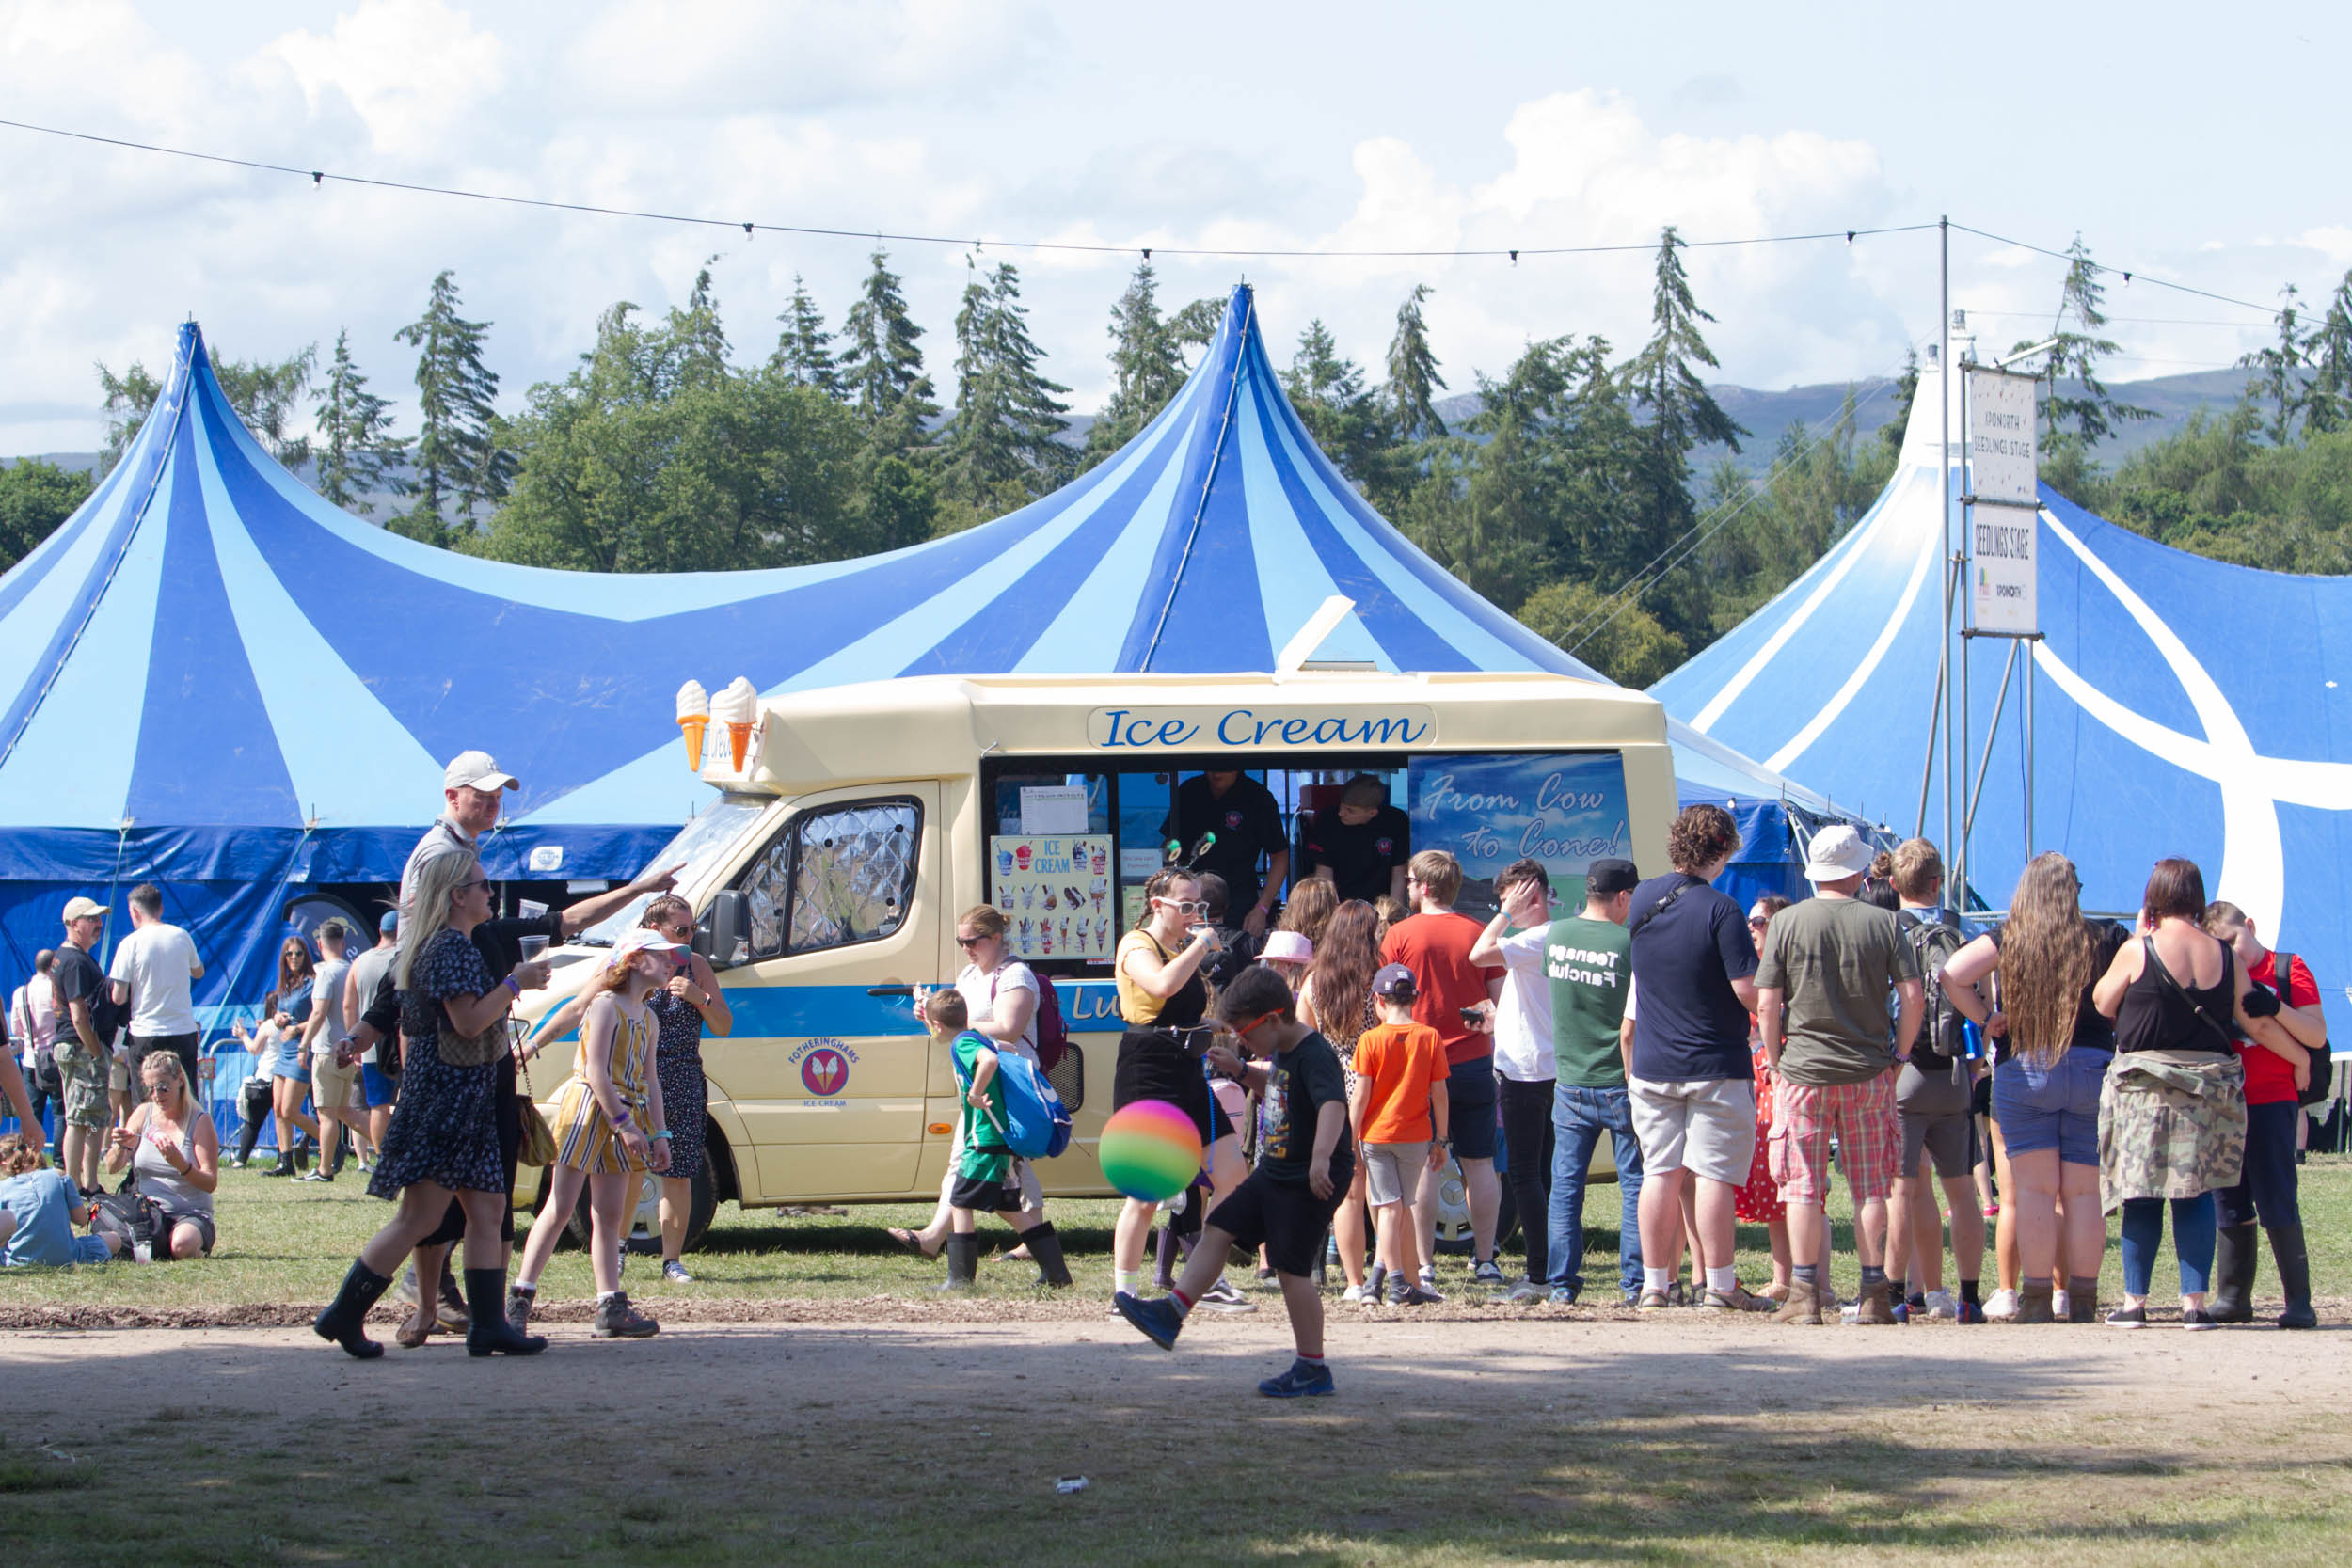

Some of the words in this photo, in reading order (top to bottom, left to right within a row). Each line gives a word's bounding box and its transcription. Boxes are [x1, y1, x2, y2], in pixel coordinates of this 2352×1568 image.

[1974, 436, 2008, 455] SEEDLINGS
[2010, 440, 2030, 459] STAGE
[1975, 523, 2008, 558] SEEDLINGS
[2010, 527, 2030, 560] STAGE
[1100, 709, 1200, 747] Ice
[1216, 709, 1427, 746] Cream
[1423, 774, 1520, 820] From
[1535, 772, 1605, 812] Cow
[1043, 840, 1061, 856] ICE
[1461, 825, 1499, 858] to
[1518, 818, 1625, 858] Cone!
[1034, 857, 1071, 874] CREAM
[787, 1037, 860, 1064] FOTHERINGHAMS
